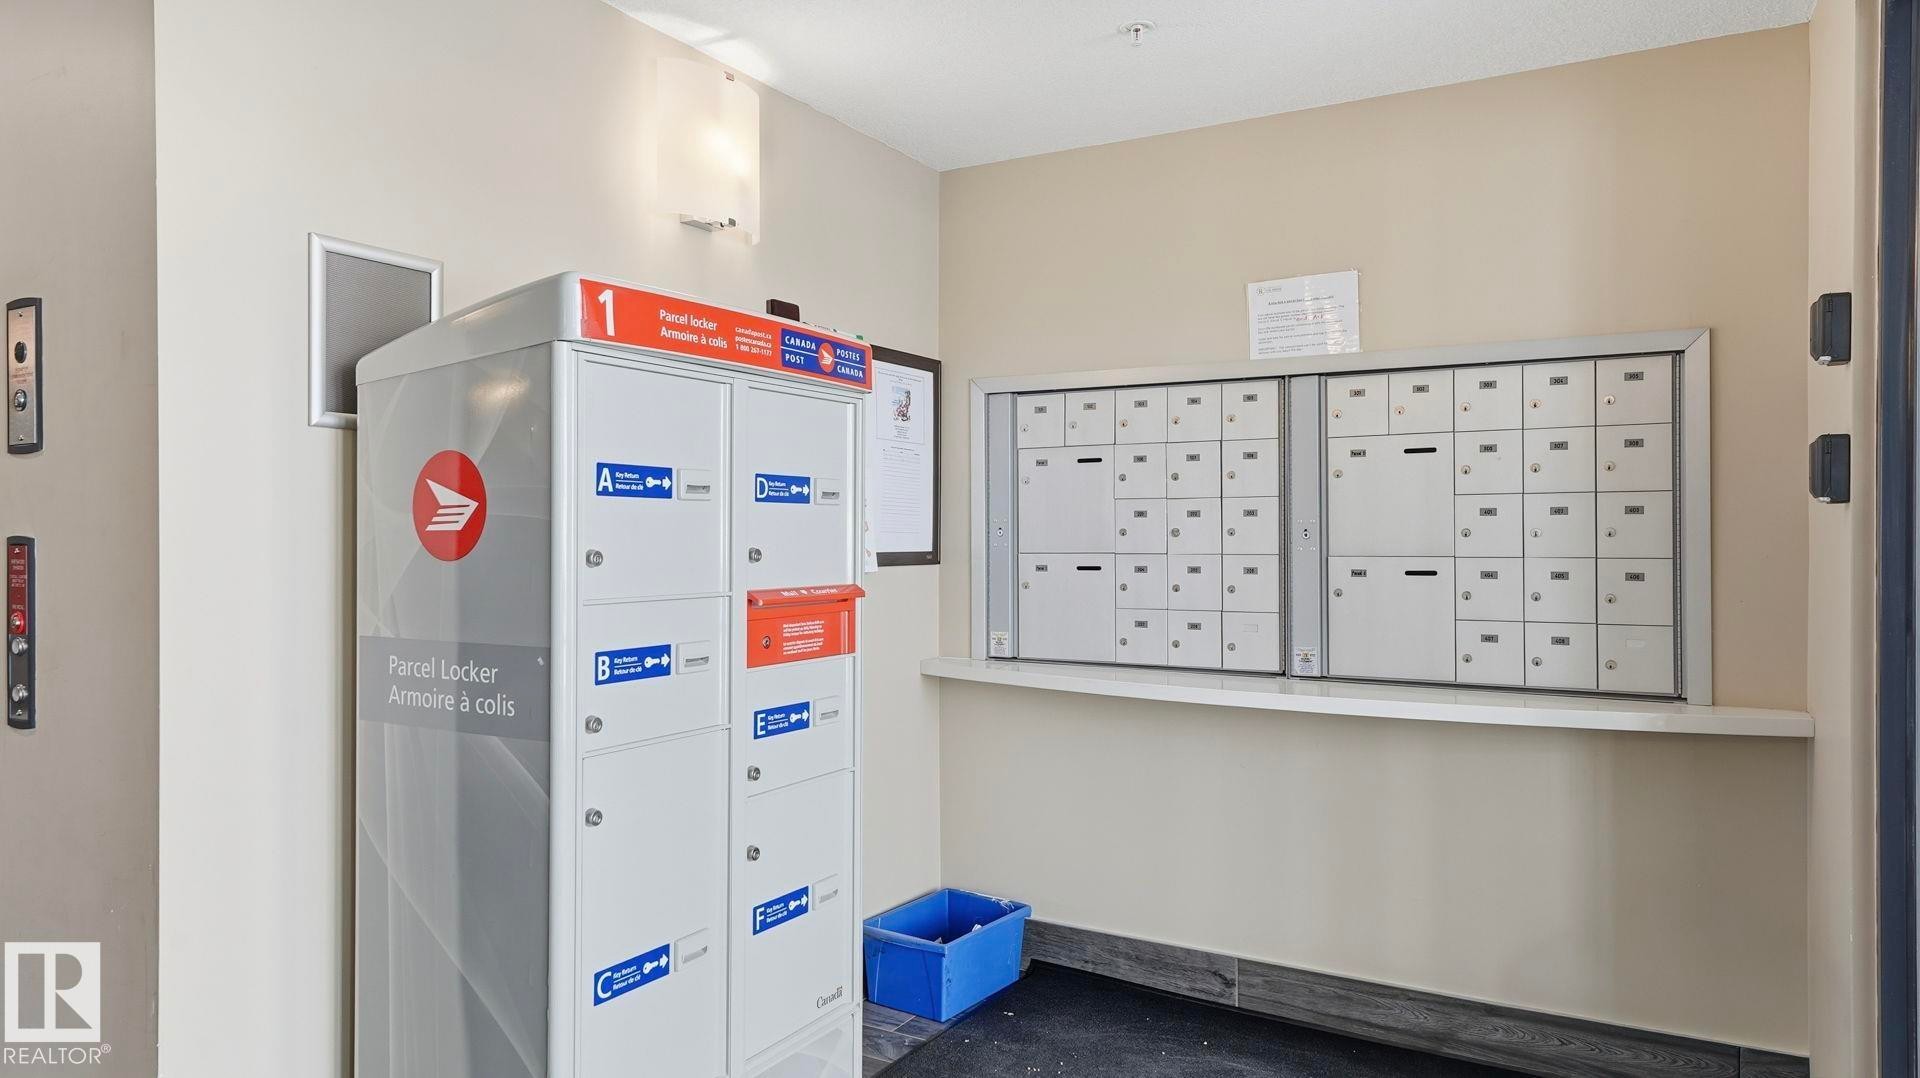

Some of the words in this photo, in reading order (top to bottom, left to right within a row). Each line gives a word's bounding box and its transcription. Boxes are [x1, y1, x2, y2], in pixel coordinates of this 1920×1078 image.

[598, 289, 616, 337] 1
[659, 309, 688, 325] Parcel
[690, 315, 717, 331] locker
[660, 326, 699, 343] Armoire
[700, 333, 707, 345] à
[708, 337, 728, 349] colis
[735, 327, 772, 340] canadapost.ca
[735, 336, 772, 348] postescanada.ca
[785, 335, 816, 351] CANADA
[785, 353, 805, 365] POST
[836, 348, 861, 361] POSTES
[837, 365, 863, 378] CANADA
[597, 467, 614, 492] A
[757, 477, 769, 499] D
[389, 655, 435, 679] Parcel
[441, 659, 499, 684] Locker
[598, 656, 610, 681] B
[388, 684, 455, 711] Armoire
[459, 690, 470, 713] à
[475, 693, 516, 717] colis
[757, 713, 766, 736] E
[756, 906, 765, 931] F
[597, 971, 612, 999] C
[816, 985, 843, 1009] Canada
